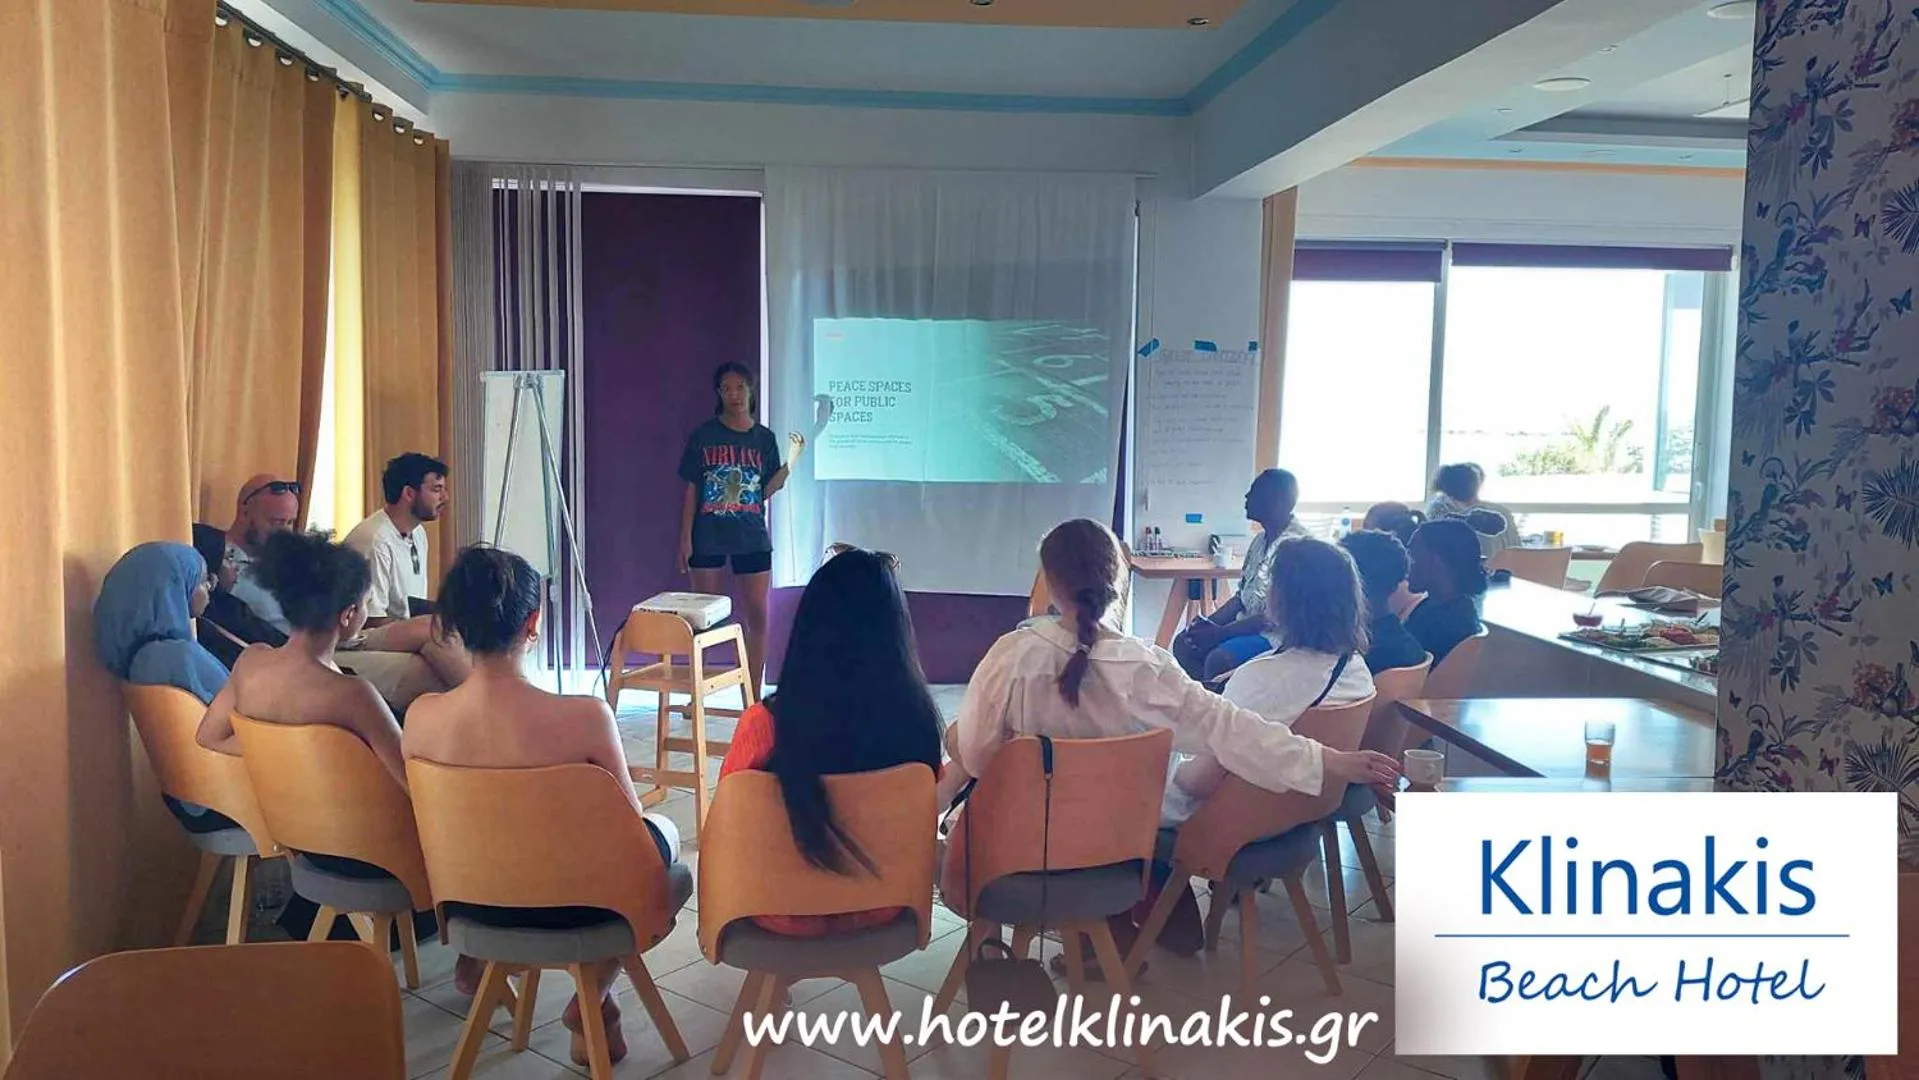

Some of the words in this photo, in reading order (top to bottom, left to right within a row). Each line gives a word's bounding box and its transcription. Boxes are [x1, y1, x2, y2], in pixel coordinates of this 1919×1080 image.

[829, 381, 866, 392] PEACE
[868, 381, 912, 393] SPACES
[854, 395, 896, 408] PUBLIC
[829, 411, 873, 423] SPACES
